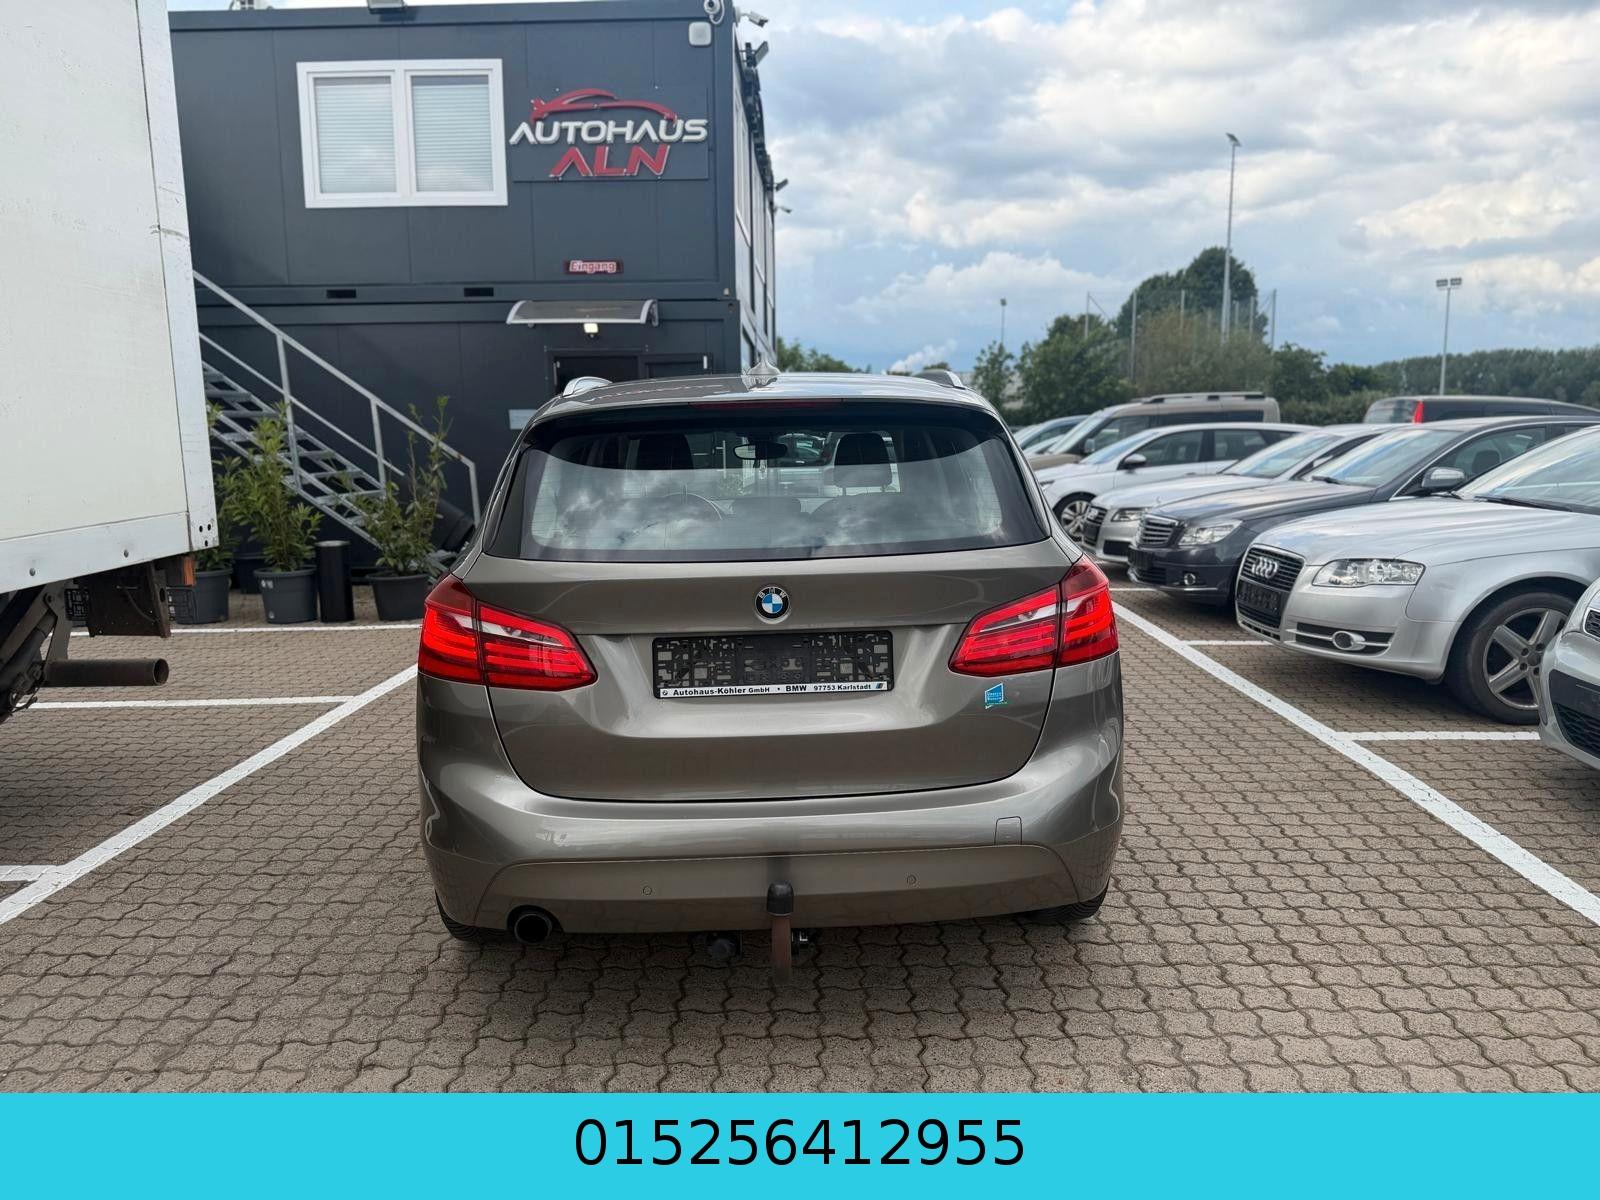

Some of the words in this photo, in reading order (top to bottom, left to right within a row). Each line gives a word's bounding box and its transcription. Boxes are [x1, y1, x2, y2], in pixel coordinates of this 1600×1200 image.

[509, 118, 709, 145] AUTOHAUS
[549, 144, 671, 178] ALN
[569, 260, 617, 274] Eingang
[673, 687, 746, 697] Autohaus-Köhler
[748, 686, 770, 694] GmbH
[785, 684, 807, 692] BMW
[837, 683, 871, 691] Karlstadt
